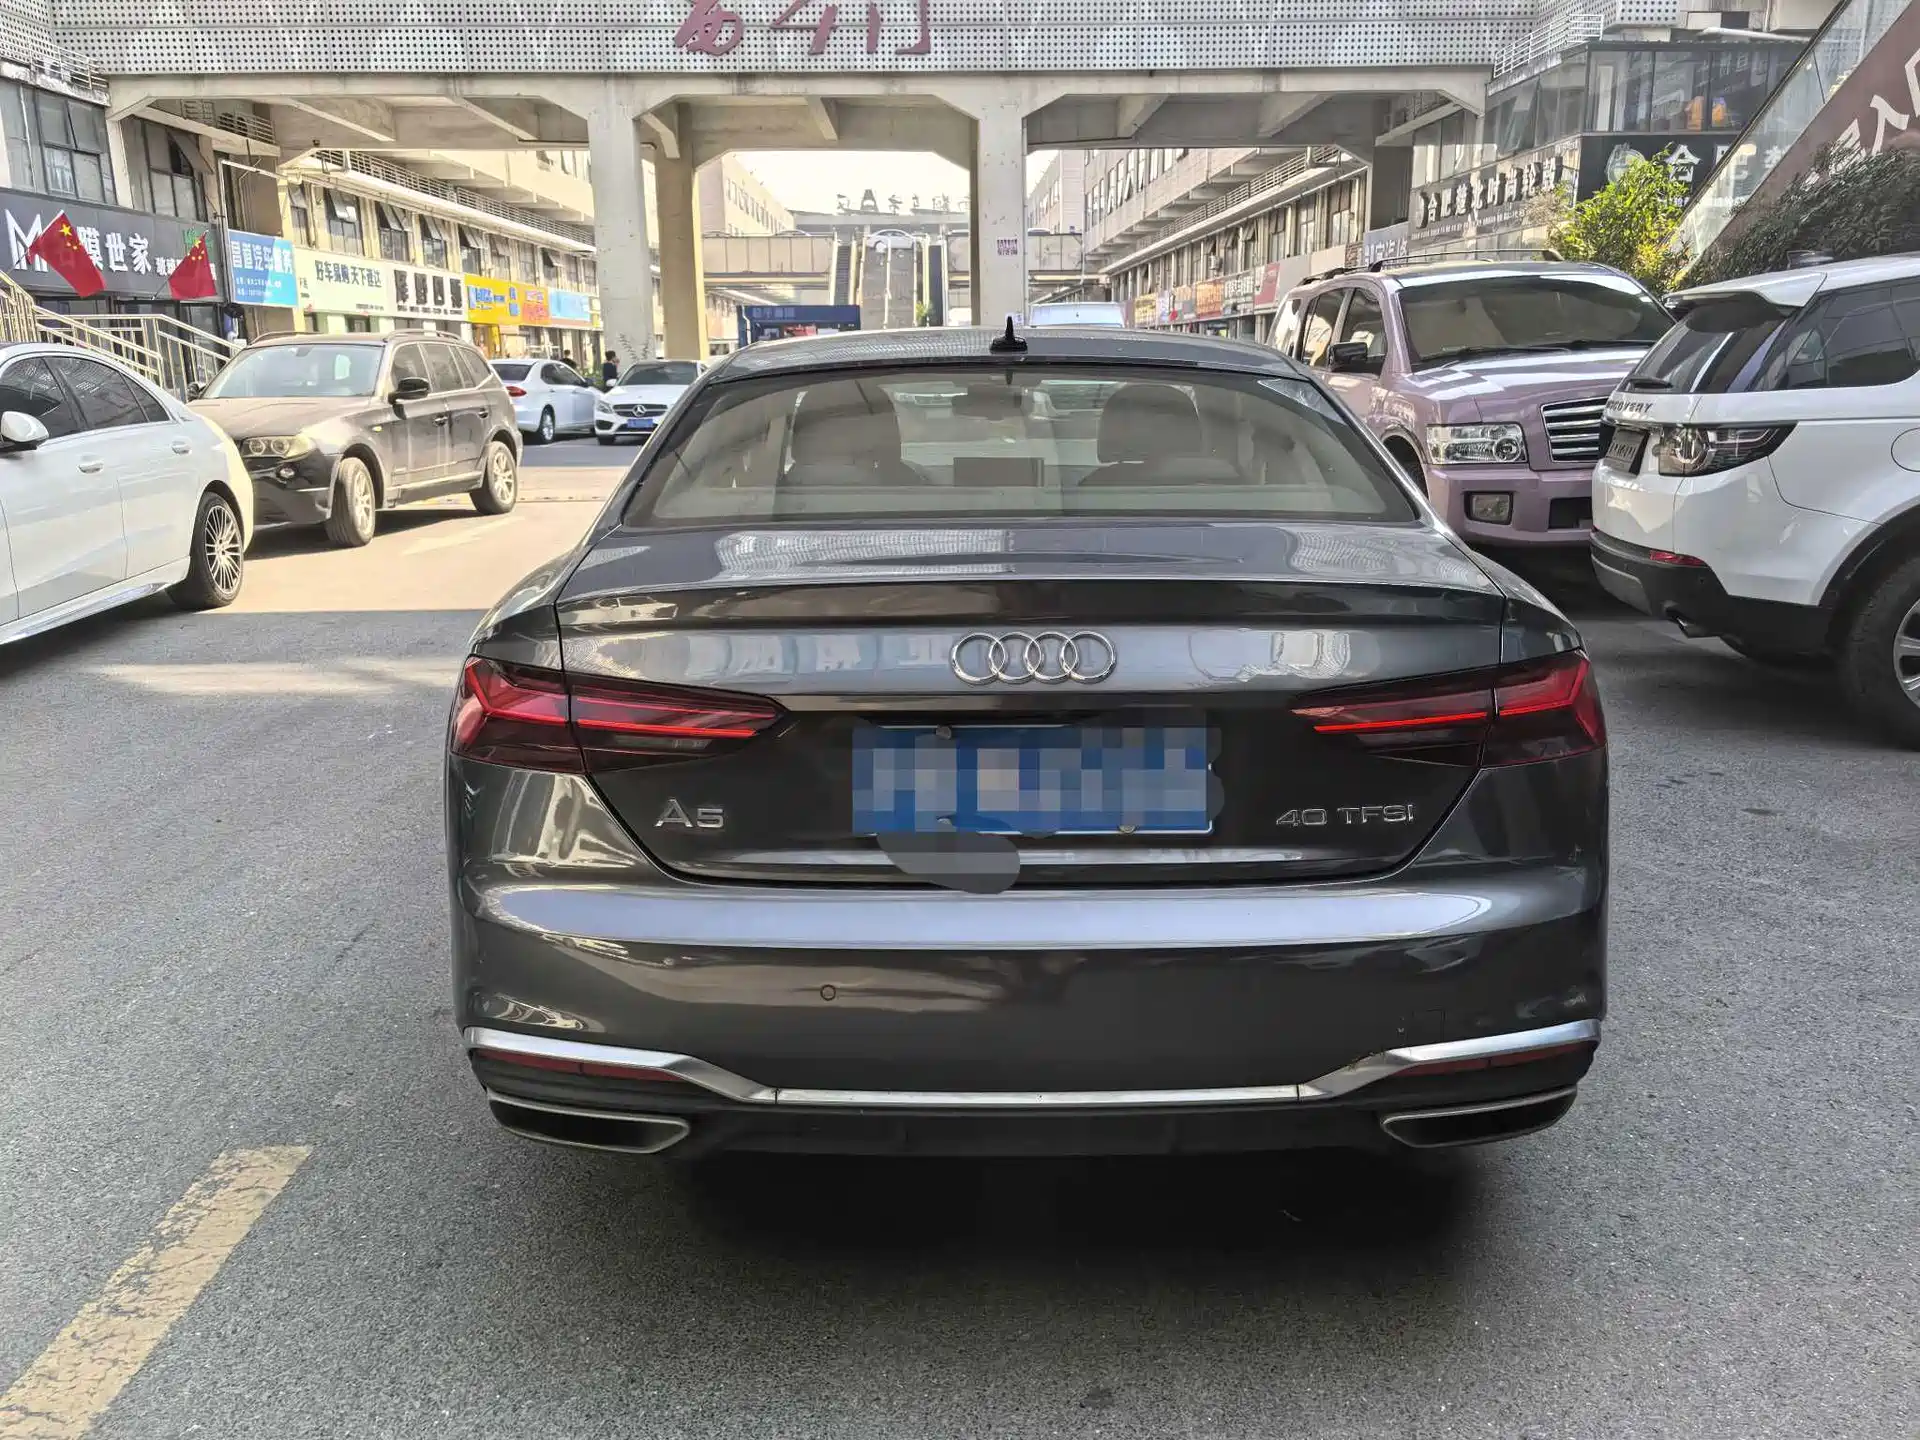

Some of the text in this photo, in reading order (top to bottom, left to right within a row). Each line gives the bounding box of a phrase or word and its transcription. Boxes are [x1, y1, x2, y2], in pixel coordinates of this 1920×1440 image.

[654, 797, 725, 829] A5
[1275, 803, 1415, 828] 40 TFSI
